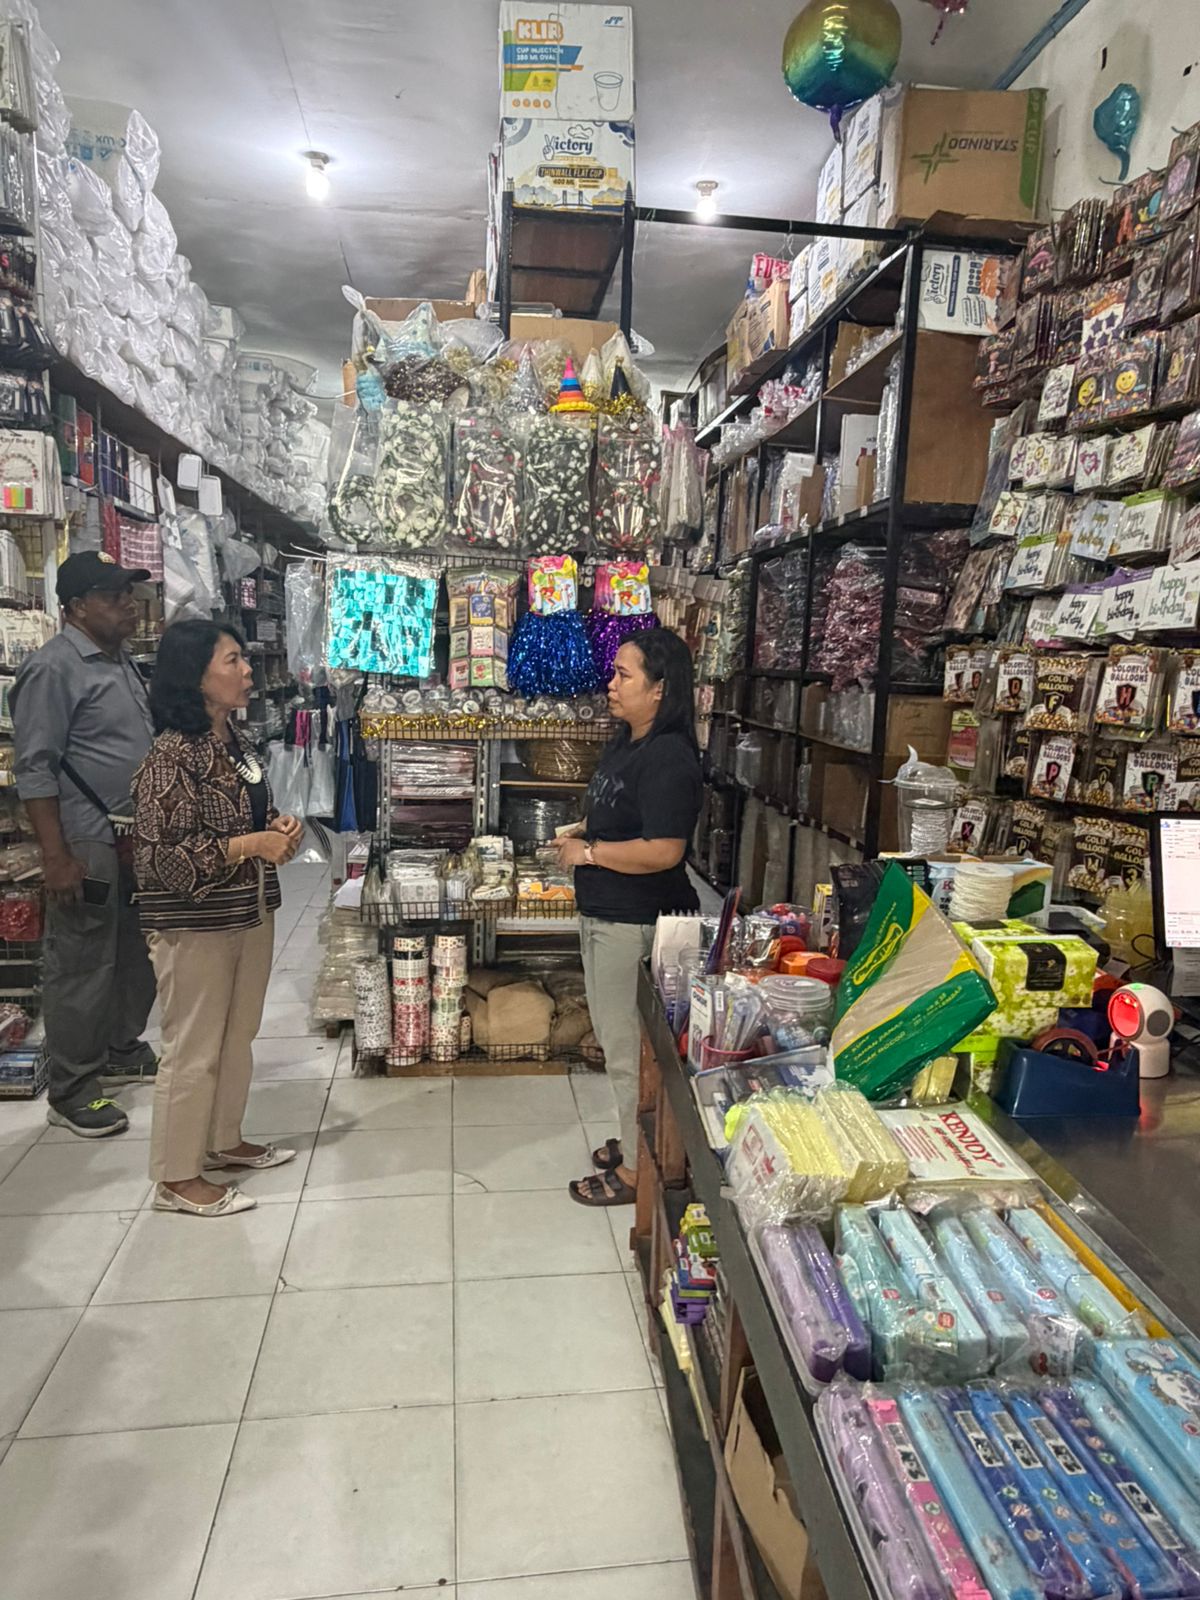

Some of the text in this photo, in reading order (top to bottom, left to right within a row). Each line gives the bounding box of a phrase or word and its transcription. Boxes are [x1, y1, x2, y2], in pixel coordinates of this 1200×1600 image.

[530, 47, 564, 55] INJECTION
[544, 133, 593, 155] Victory
[947, 136, 1019, 153] STARINDO
[573, 168, 589, 178] FLAT
[590, 168, 603, 178] CUP
[1159, 570, 1187, 597] happy
[1115, 586, 1135, 604] happy
[1106, 607, 1134, 621] birthday
[1149, 597, 1186, 621] birthday
[1111, 664, 1149, 674] COLORFUL
[1047, 675, 1069, 684] GOLD
[1110, 673, 1149, 682] BALLOONS
[1038, 682, 1075, 693] BALLOONS
[1119, 686, 1133, 706] H
[1134, 751, 1178, 762] COLORFUL
[1133, 760, 1178, 770] BALLOONS
[1085, 835, 1107, 846] GOLD
[1125, 846, 1145, 857] GOL
[878, 1030, 906, 1054] BOCOR
[937, 1110, 998, 1164] KENJOY
